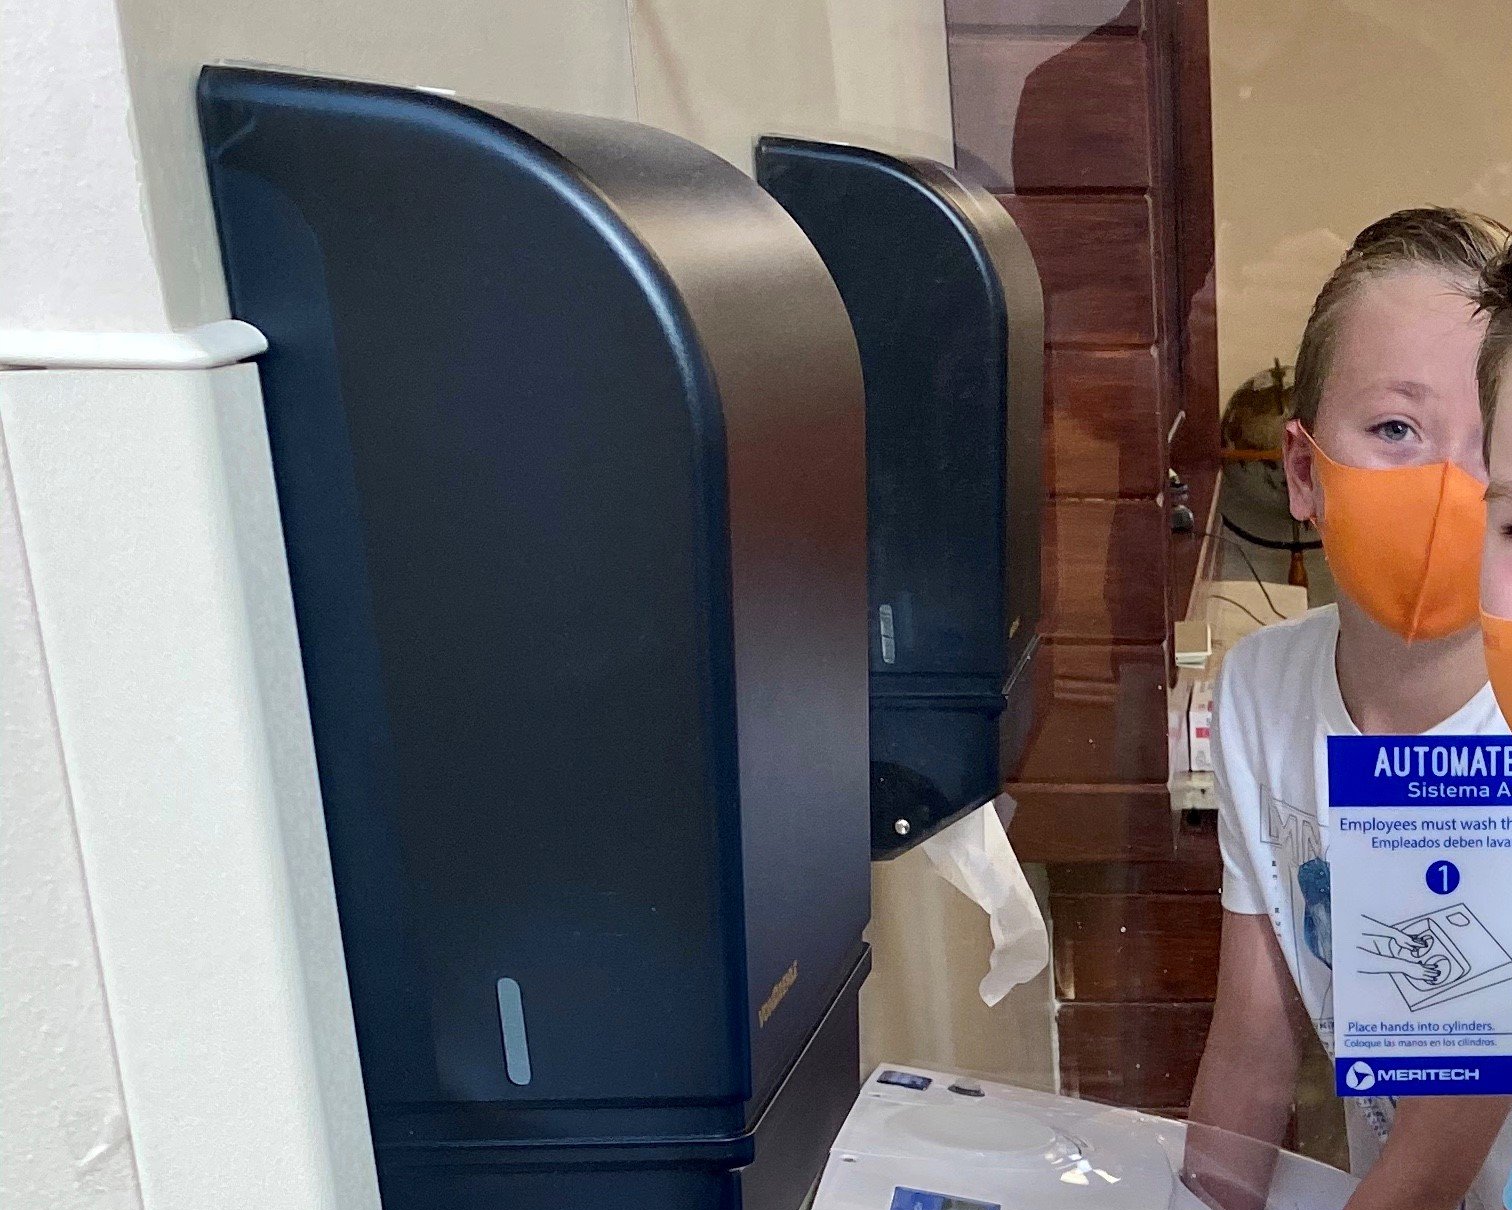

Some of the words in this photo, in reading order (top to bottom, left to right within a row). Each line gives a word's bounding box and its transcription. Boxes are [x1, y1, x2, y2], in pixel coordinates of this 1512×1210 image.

[1407, 782, 1490, 798] Sistema
[1340, 817, 1417, 833] Employees
[1421, 819, 1457, 830] must
[1460, 817, 1497, 830] wash
[1371, 836, 1440, 850] Empleados
[1443, 836, 1483, 848] deben
[1437, 865, 1449, 891] 1
[1348, 1021, 1378, 1032] Place
[1380, 1020, 1414, 1031] hands
[1417, 1020, 1439, 1031] into
[1442, 1019, 1495, 1034] cylinders.
[1384, 1038, 1396, 1048] las
[1398, 1039, 1426, 1048] manos
[1443, 1037, 1456, 1047] los
[1377, 1069, 1480, 1081] MERITECH
